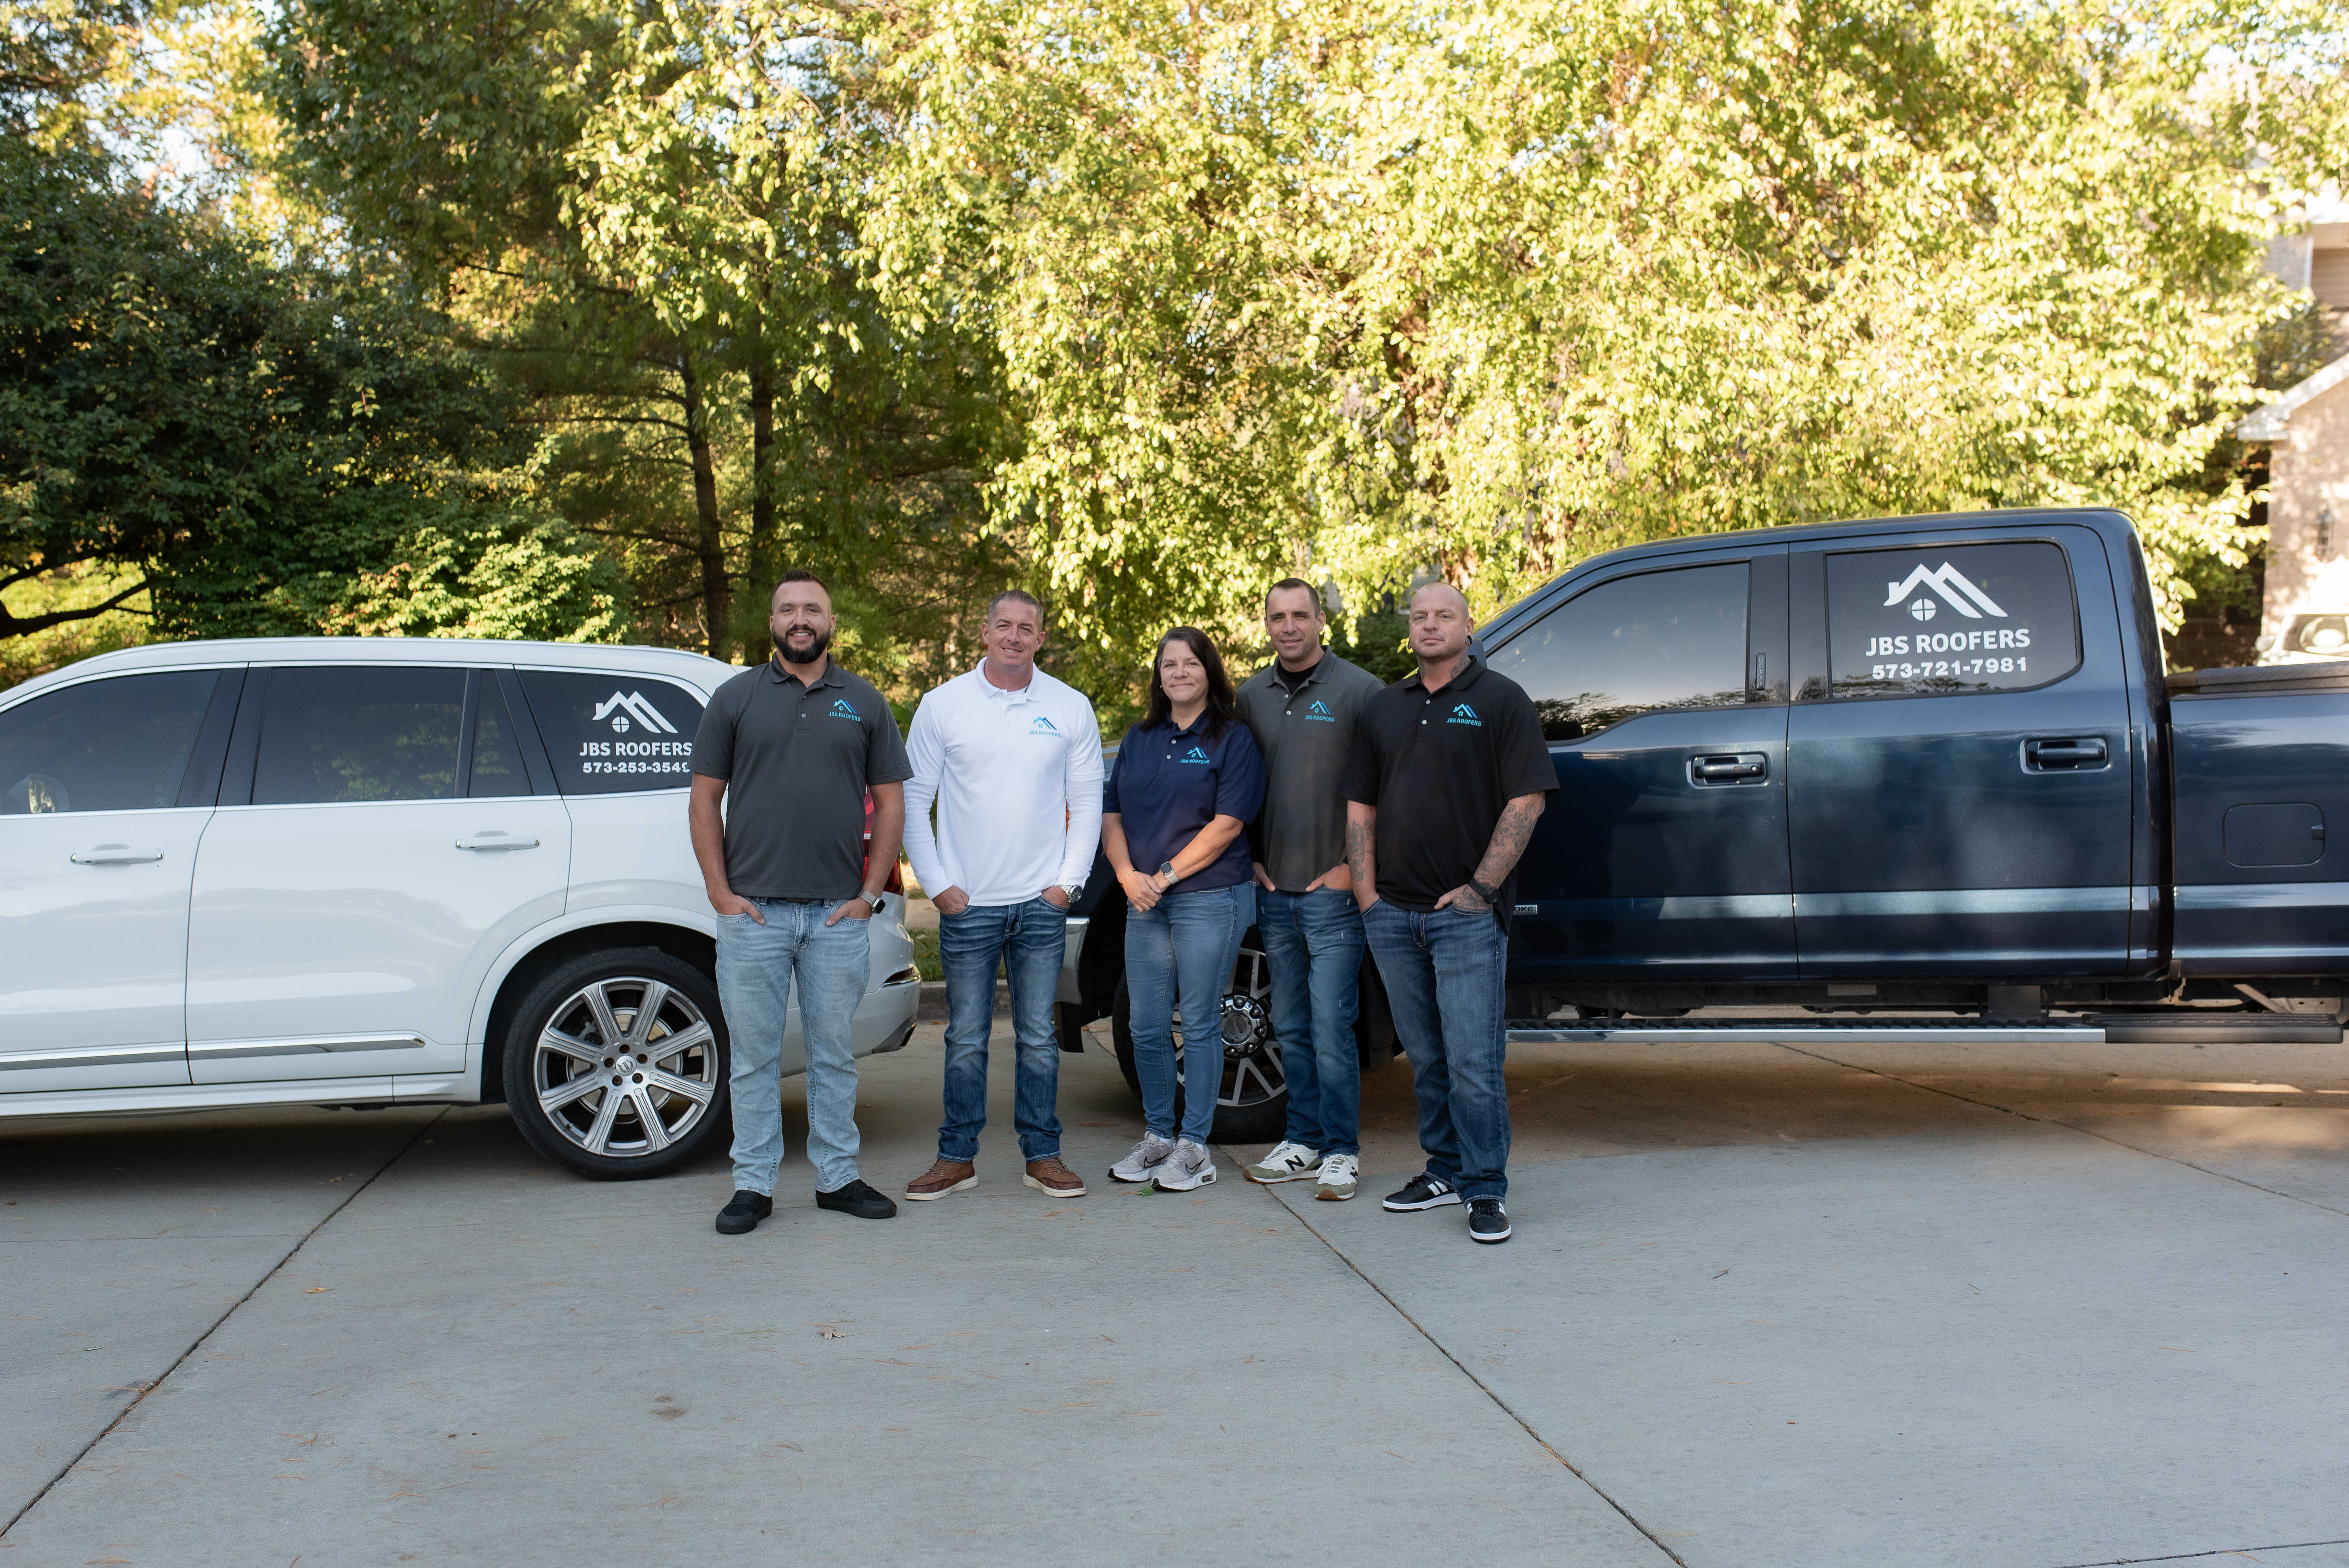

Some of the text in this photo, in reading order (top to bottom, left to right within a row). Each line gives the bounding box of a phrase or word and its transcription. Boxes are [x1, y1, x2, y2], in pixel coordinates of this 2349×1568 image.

[1865, 629, 2030, 656] JBS ROOFERS
[1872, 657, 2026, 680] 573-721-7981
[839, 713, 861, 722] ROOFERS
[579, 742, 692, 756] JBS ROOFERS
[1285, 1155, 1306, 1172] N
